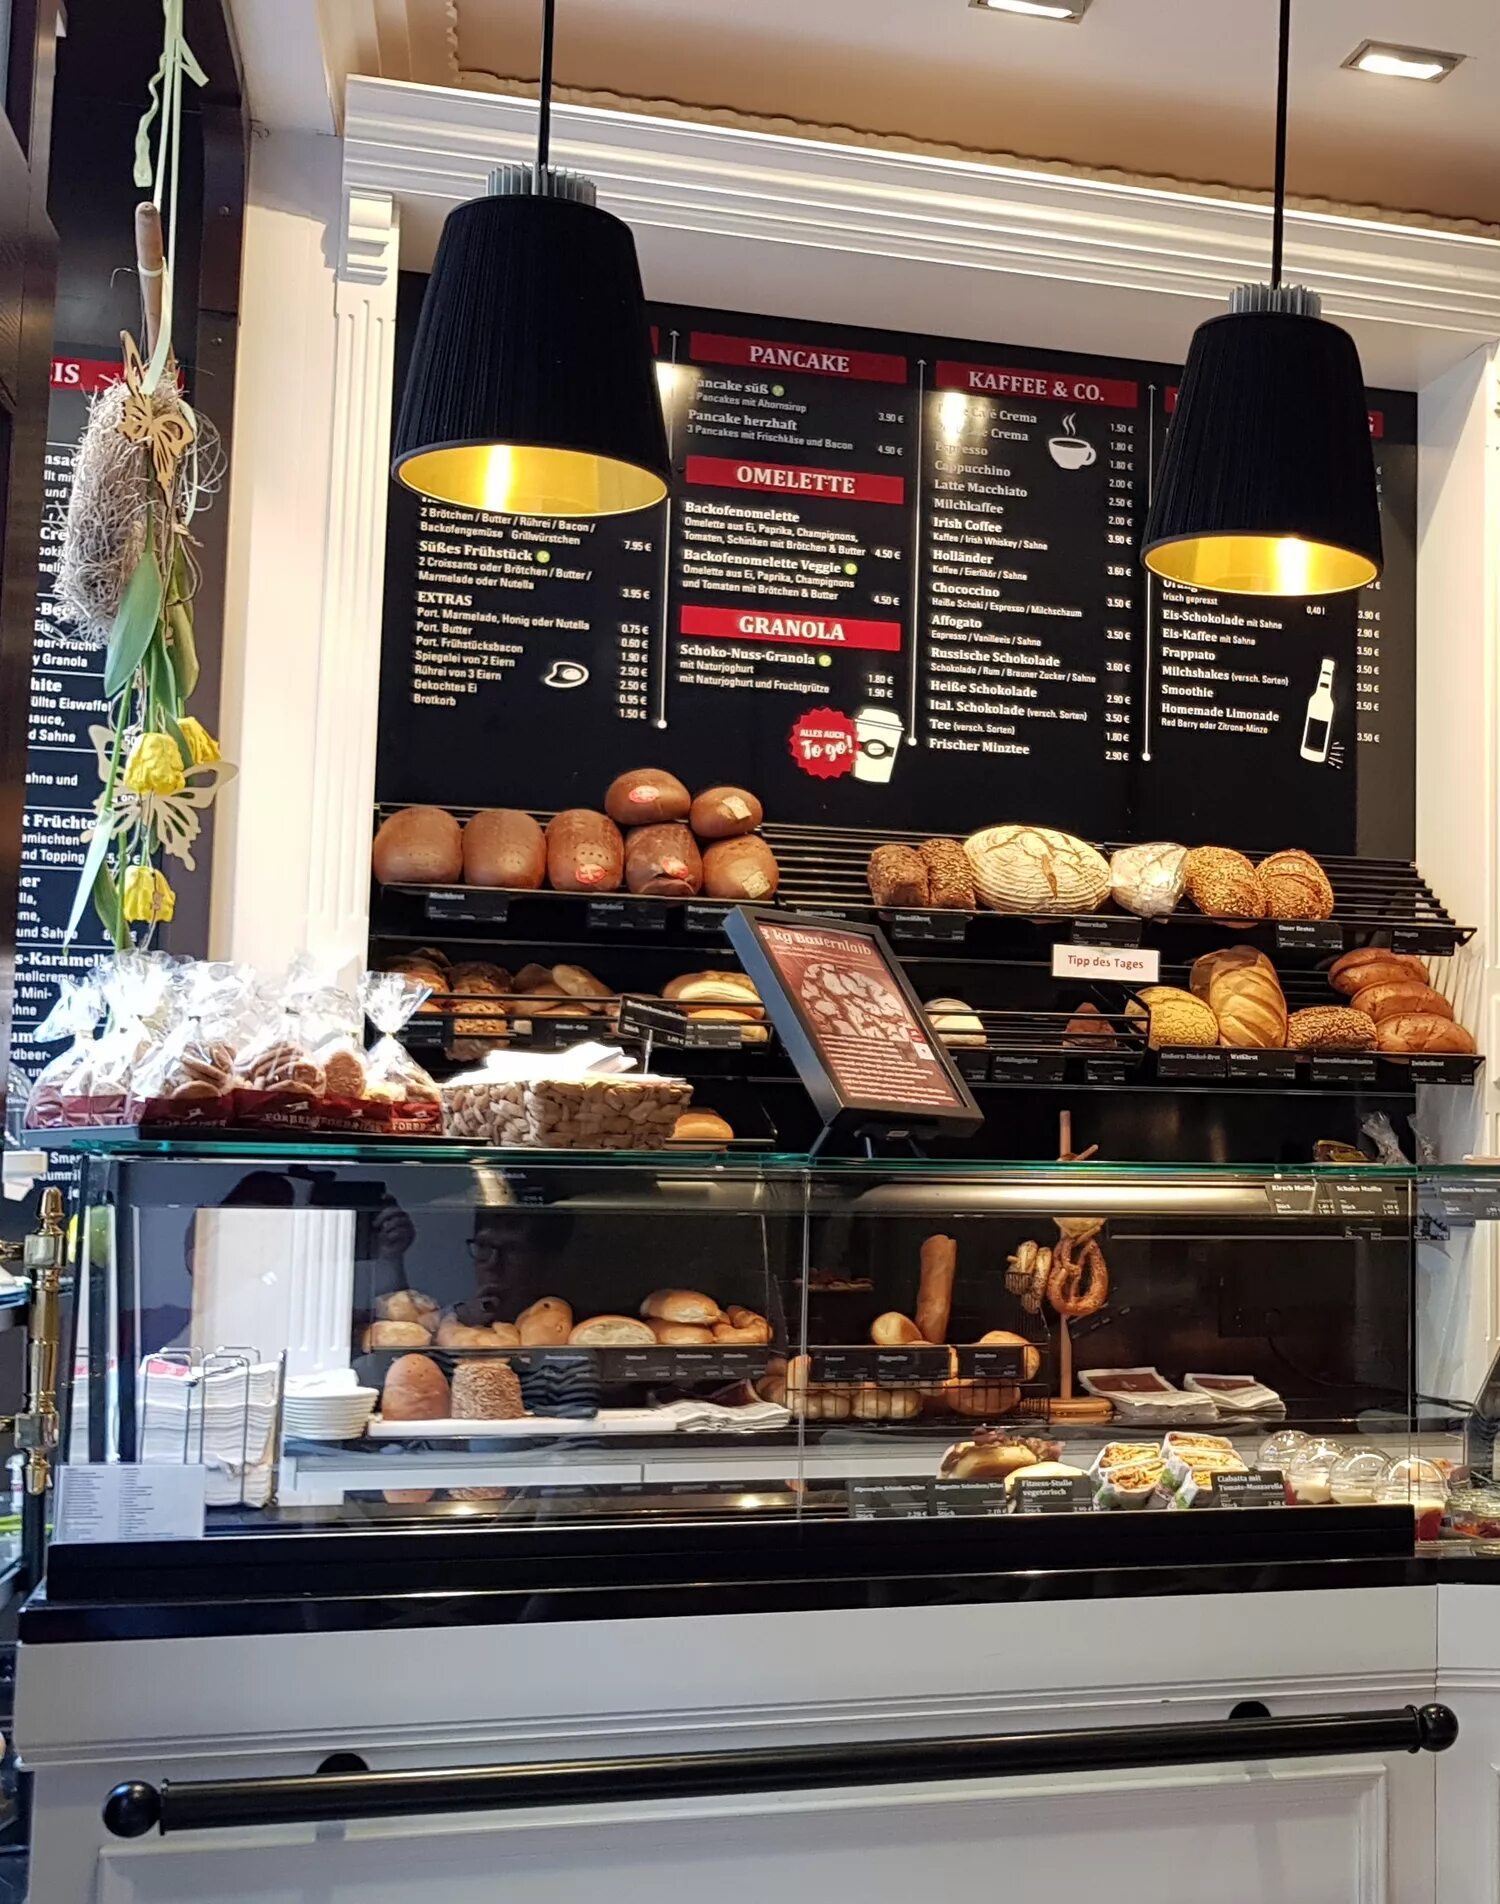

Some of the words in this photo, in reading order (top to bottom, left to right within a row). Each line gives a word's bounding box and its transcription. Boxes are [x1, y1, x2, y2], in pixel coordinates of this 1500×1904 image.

[751, 346, 849, 372] PANCAKE
[51, 363, 80, 384] IS
[698, 380, 742, 391] ancake
[970, 371, 1046, 395] KAFFEE
[1053, 381, 1068, 397] &
[1074, 383, 1104, 400] CO.
[688, 409, 741, 424] Pancake
[744, 415, 797, 430] herzhaft
[695, 425, 738, 437] Pancakes
[741, 430, 755, 439] mit
[757, 431, 804, 444] Frischkäse
[825, 439, 852, 449] Bacon
[737, 466, 854, 493] OMELETTE
[935, 479, 964, 491] Latte
[968, 482, 1027, 497] Macchiato
[686, 502, 799, 522] Backofenomelette
[934, 498, 1003, 513] Milchkaffee
[420, 521, 503, 538] Backofengemüse
[933, 517, 962, 529] Irish
[965, 520, 1002, 532] Coffee
[511, 529, 580, 544] Grillwürstchen
[419, 541, 461, 554] Süßes
[464, 544, 532, 561] Frühstück
[624, 541, 642, 550] 7.95
[684, 549, 798, 569] Backofenomelette
[800, 560, 841, 574] Veggie
[933, 549, 993, 564] Holländer
[419, 570, 473, 584] Marmelade
[476, 577, 497, 585] oder
[500, 578, 534, 589] Nutella
[682, 579, 700, 588] und
[702, 579, 740, 591] Tomaten
[742, 584, 756, 592] mit
[758, 585, 799, 596] Brötchen
[801, 589, 808, 597] &
[811, 589, 838, 599] Butter
[932, 582, 1000, 597] Chococcino
[418, 591, 472, 606] EXTRAS
[874, 595, 891, 604] 4.50
[417, 607, 439, 617] Port.
[442, 609, 500, 623] Marmelade,
[502, 614, 529, 626] Honig
[532, 617, 553, 626] oder
[556, 618, 589, 630] Nutella
[932, 615, 982, 629] Affogato
[1163, 609, 1244, 625] Eis-Schokolade
[1247, 619, 1258, 627] mit
[1260, 619, 1282, 629] Sahne
[622, 624, 640, 633] 0.75
[739, 616, 845, 640] GRANOLA
[416, 636, 438, 646] Port.
[441, 637, 523, 653] Frühstücksbacon
[1163, 628, 1217, 642] Eis-Kaffee
[1220, 635, 1230, 643] mit
[1233, 636, 1255, 645] Sahne
[42, 653, 88, 669] Granola
[415, 650, 460, 663] Spiegelei
[462, 656, 480, 664] von
[480, 655, 488, 665] 2
[491, 656, 515, 666] Eiern
[681, 644, 815, 664] Schoko-Nuss-Granola
[931, 647, 990, 661] Russische
[993, 652, 1060, 666] Schokolade
[680, 674, 694, 682] mit
[696, 674, 753, 688] Naturjoghurt
[755, 679, 772, 688] und
[774, 680, 829, 693] Fruchtgrütze
[1162, 665, 1229, 680] Milchshakes
[1231, 672, 1260, 682] (versch.
[1262, 675, 1288, 686] Sorten)
[414, 679, 465, 691] Gekochtes
[468, 683, 476, 692] Ei
[930, 680, 967, 692] Heiße
[969, 683, 1037, 697] Schokolade
[1162, 684, 1213, 697] Smoothie
[58, 698, 112, 713] Eiswaffel
[414, 694, 456, 705] Brotkorb
[930, 699, 954, 710] Ital.
[956, 701, 1025, 716] Schokolade
[1027, 708, 1057, 718] (versch.
[1060, 710, 1087, 721] Sorten)
[1162, 703, 1223, 716] Homemade
[1226, 708, 1279, 721] Limonade
[929, 718, 951, 730] Tee
[953, 722, 984, 732] (versch.
[987, 724, 1015, 735] Sorten)
[1161, 717, 1176, 726] Red
[1178, 718, 1198, 729] Berry
[1200, 721, 1216, 729] oder
[1218, 722, 1268, 733] Zitrone-Minze
[39, 730, 76, 743] Sahne
[800, 729, 823, 738] ALLES
[824, 731, 846, 740] AUCH
[801, 740, 823, 760] To
[826, 735, 854, 762] go!
[929, 738, 980, 750] Frischer
[983, 742, 1029, 754] Minztee
[34, 814, 97, 830] Früchte
[22, 835, 80, 847] emischten
[41, 850, 85, 865] Topping
[773, 930, 792, 945] kg
[795, 933, 872, 955] Bauernlaib
[1067, 955, 1090, 967] Tipp
[1092, 956, 1111, 967] des
[1114, 958, 1144, 970] Tages
[21, 987, 52, 999] Mini-
[10, 1050, 51, 1062] rdbeer-
[1021, 1479, 1073, 1488] Fitness-Stulle
